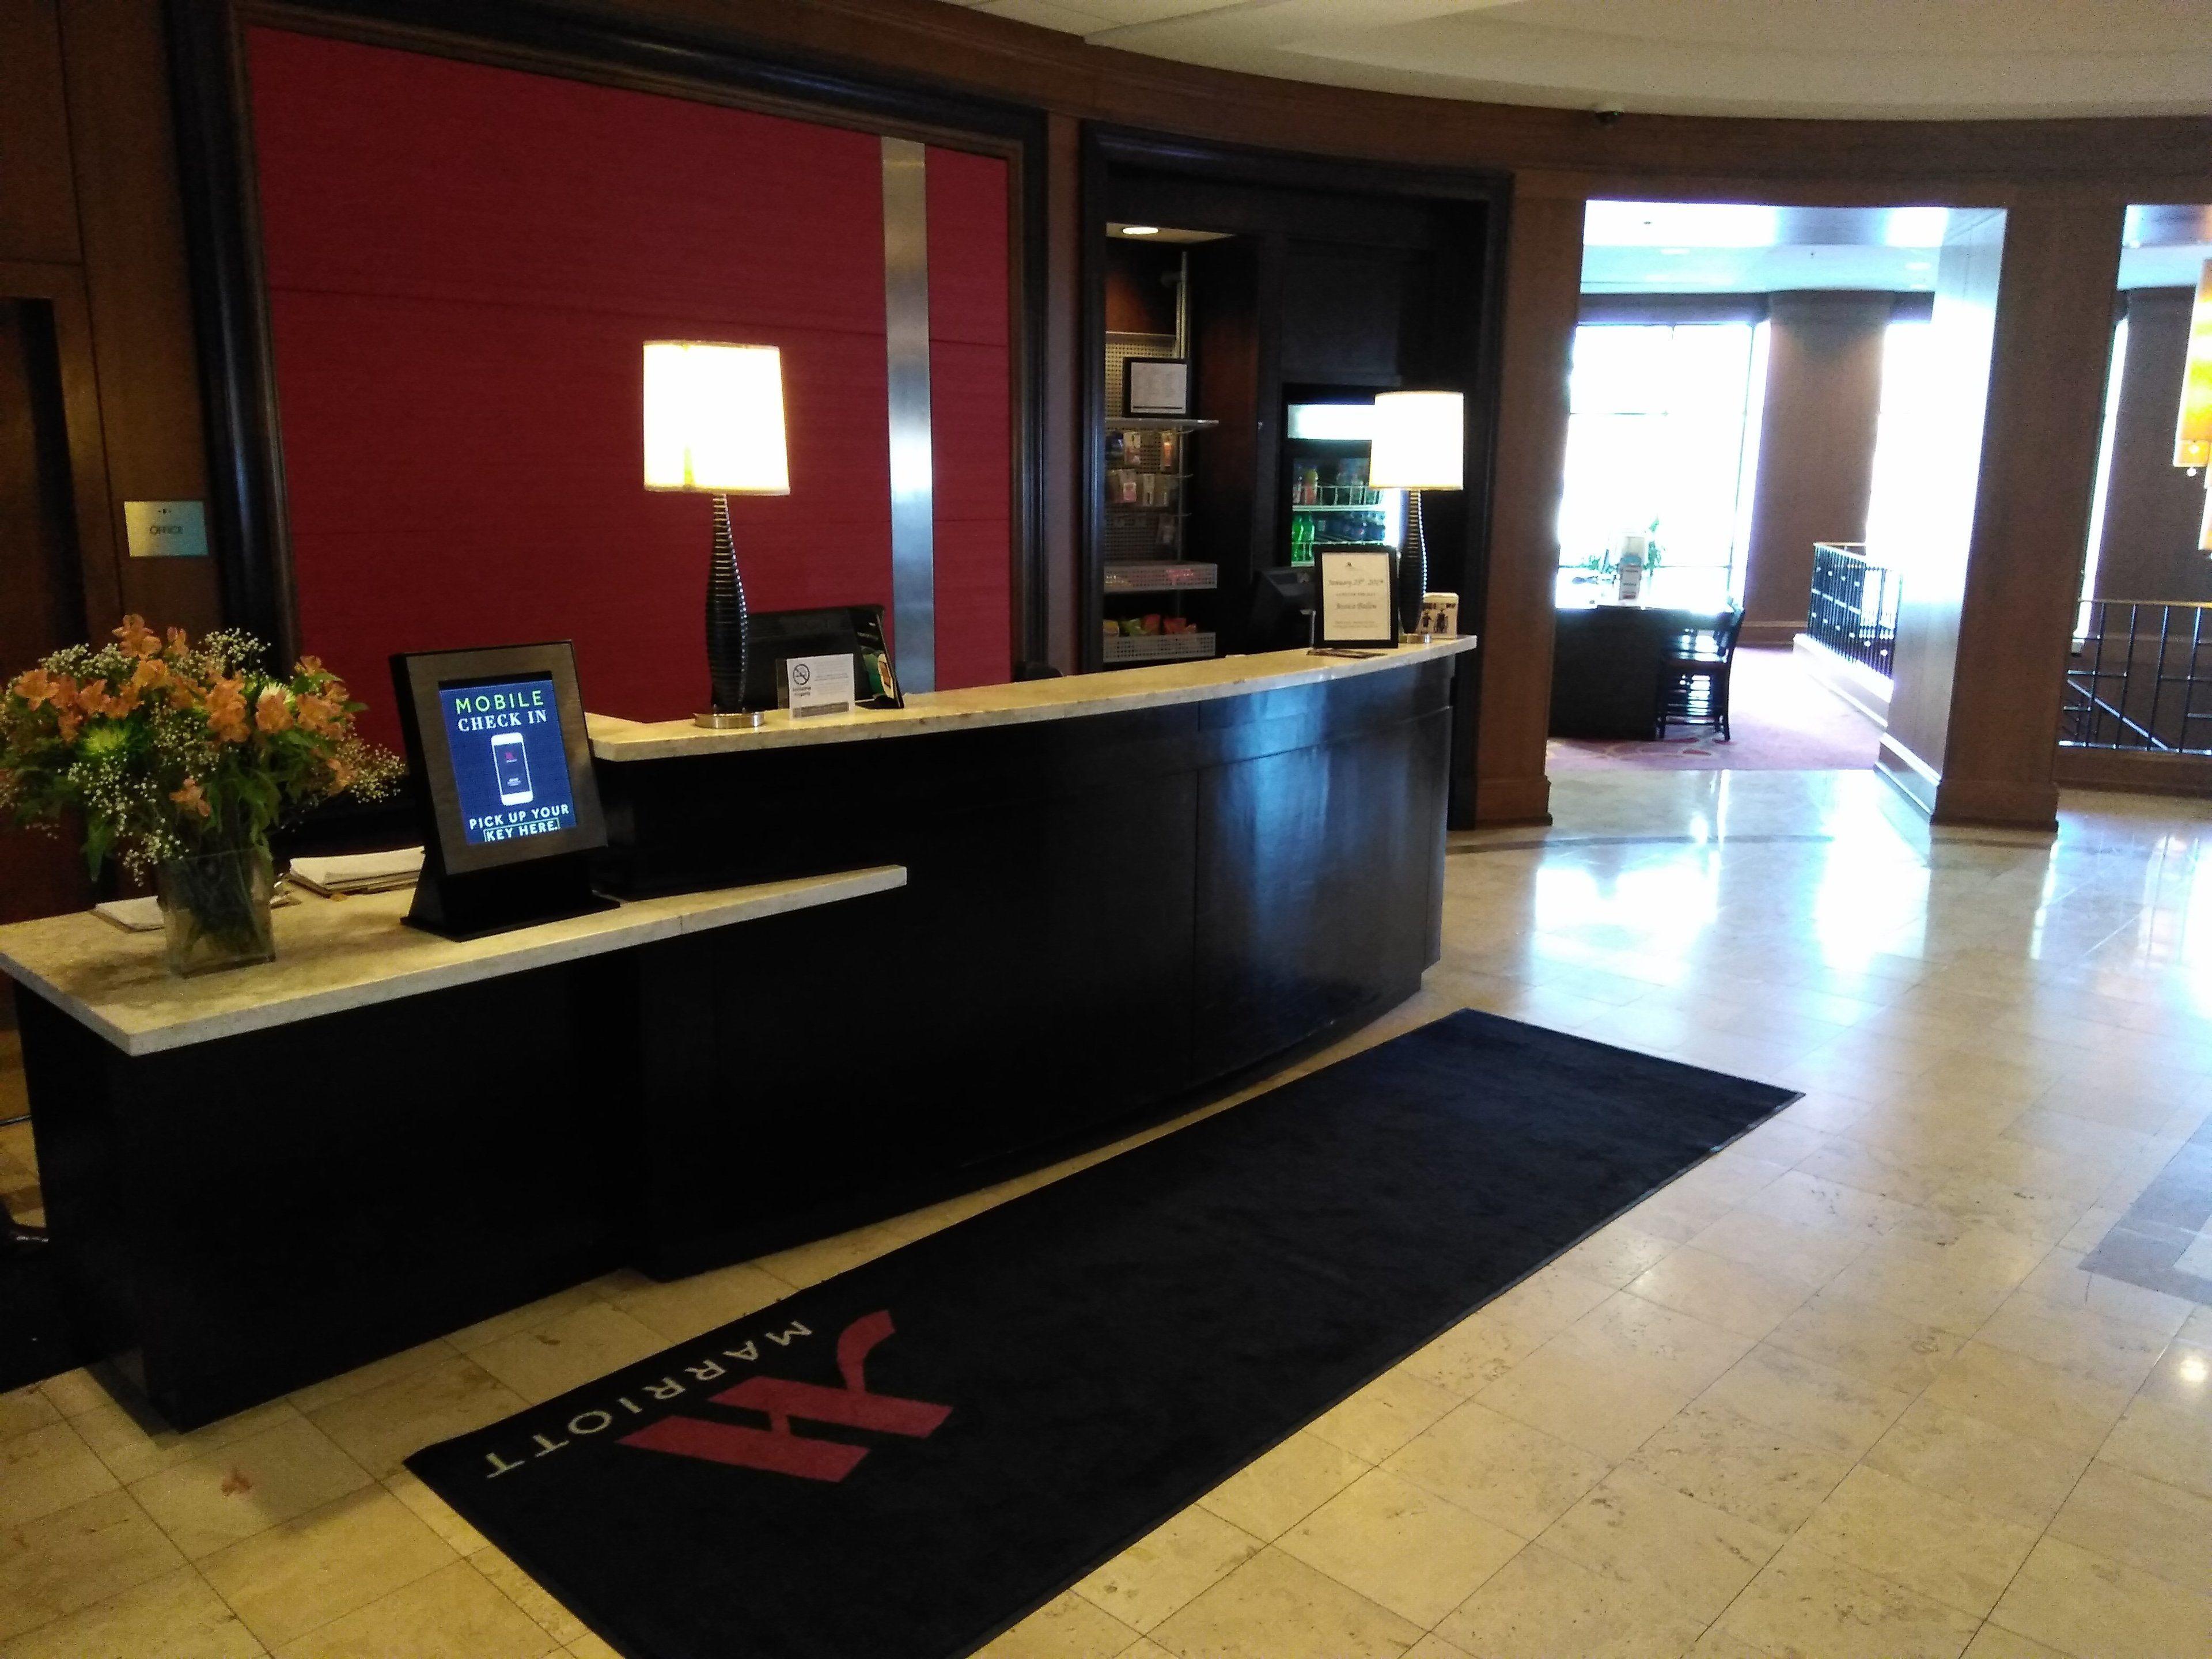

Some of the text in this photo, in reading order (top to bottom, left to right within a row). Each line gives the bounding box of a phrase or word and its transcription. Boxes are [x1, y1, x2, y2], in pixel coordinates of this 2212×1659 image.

[456, 690, 544, 714] MOBILE
[457, 709, 547, 732] CHECK IN
[469, 803, 569, 830] PICK UP YOUR
[486, 827, 513, 842] KEY
[486, 1320, 813, 1479] MARRIOTT
